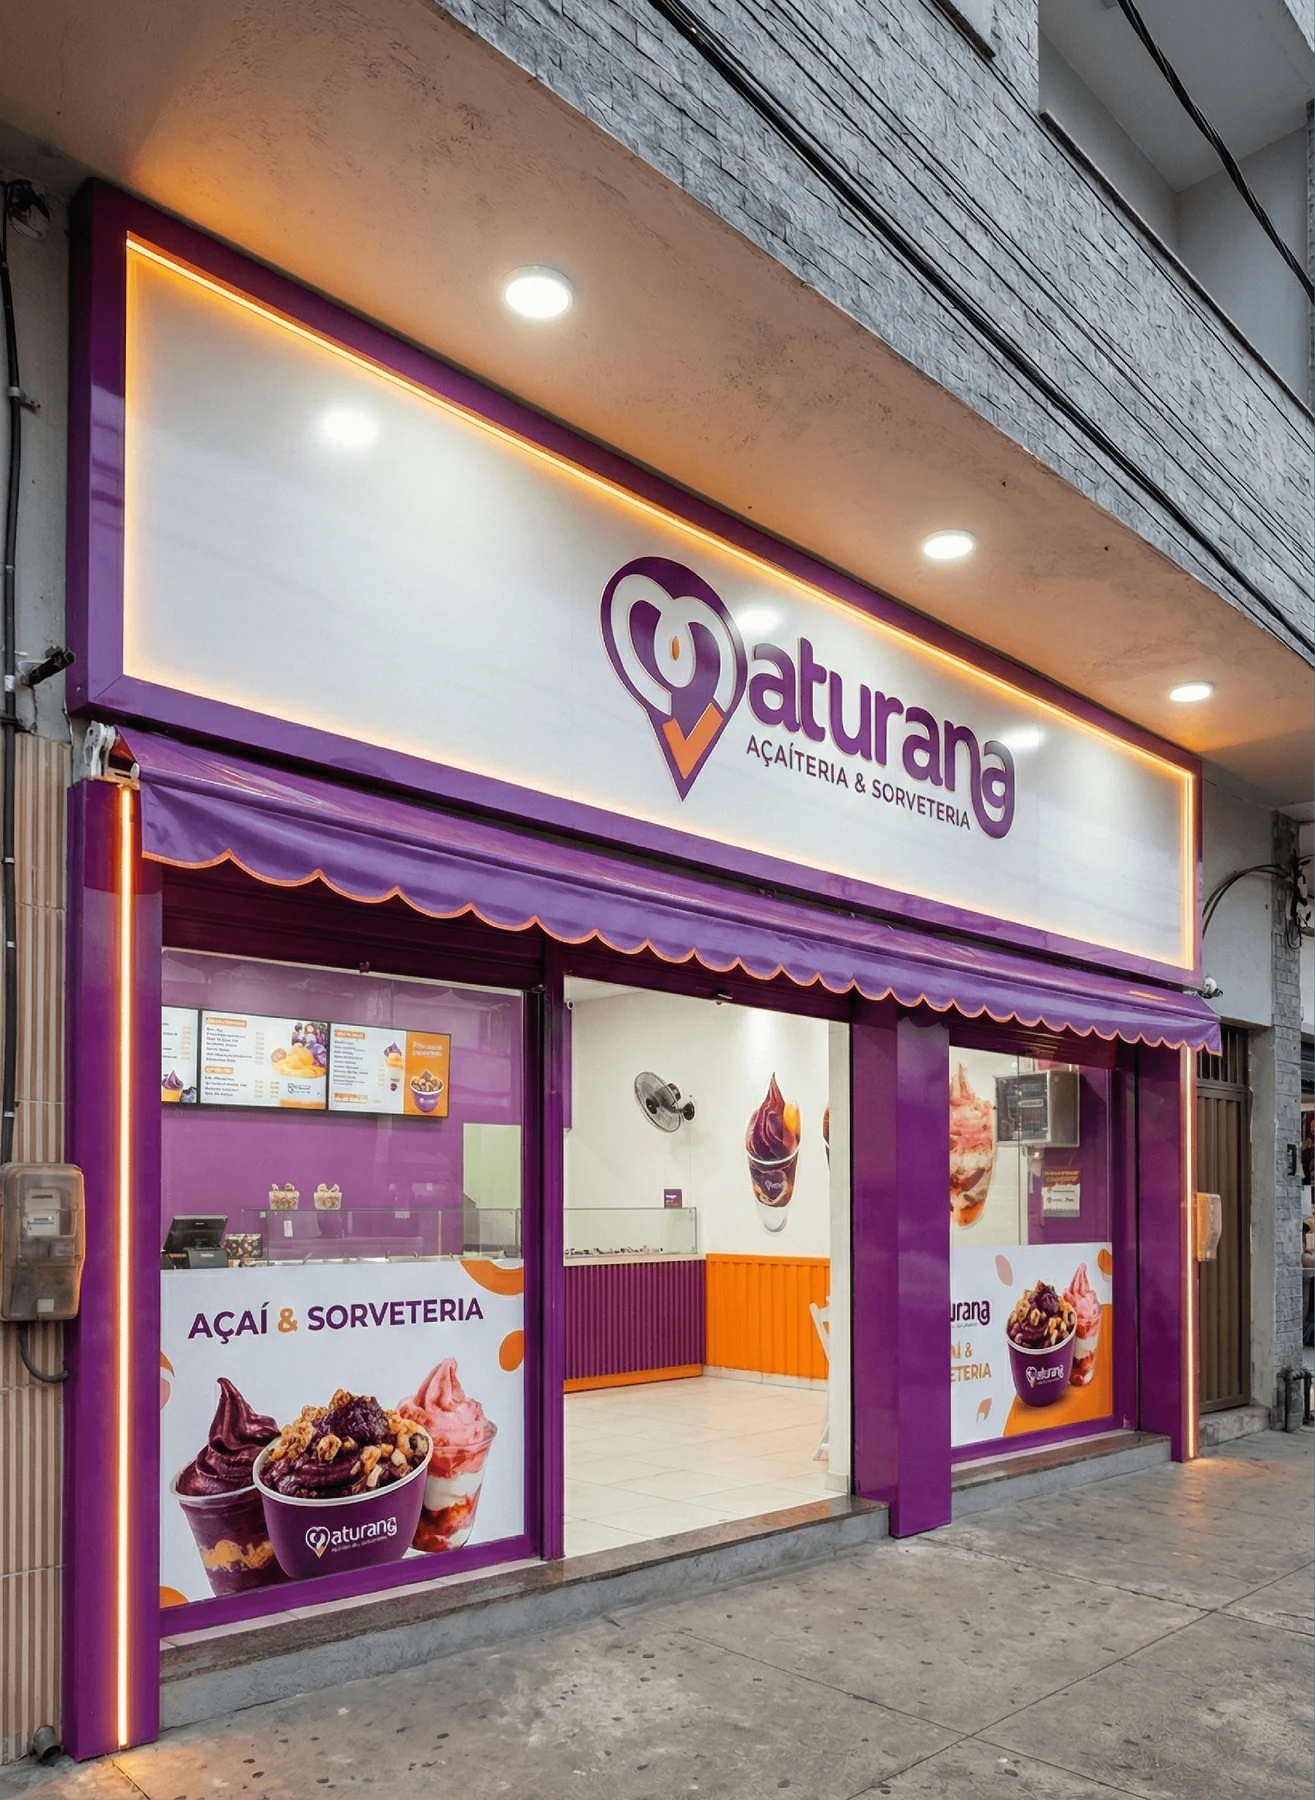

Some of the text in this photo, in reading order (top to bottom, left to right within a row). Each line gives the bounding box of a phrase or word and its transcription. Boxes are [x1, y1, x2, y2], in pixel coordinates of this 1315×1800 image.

[745, 734, 971, 831] AÇAÍTERIA & SORVETERIA
[187, 1297, 484, 1344] AÇAÍ & SORVETERIA
[965, 1342, 972, 1358] &
